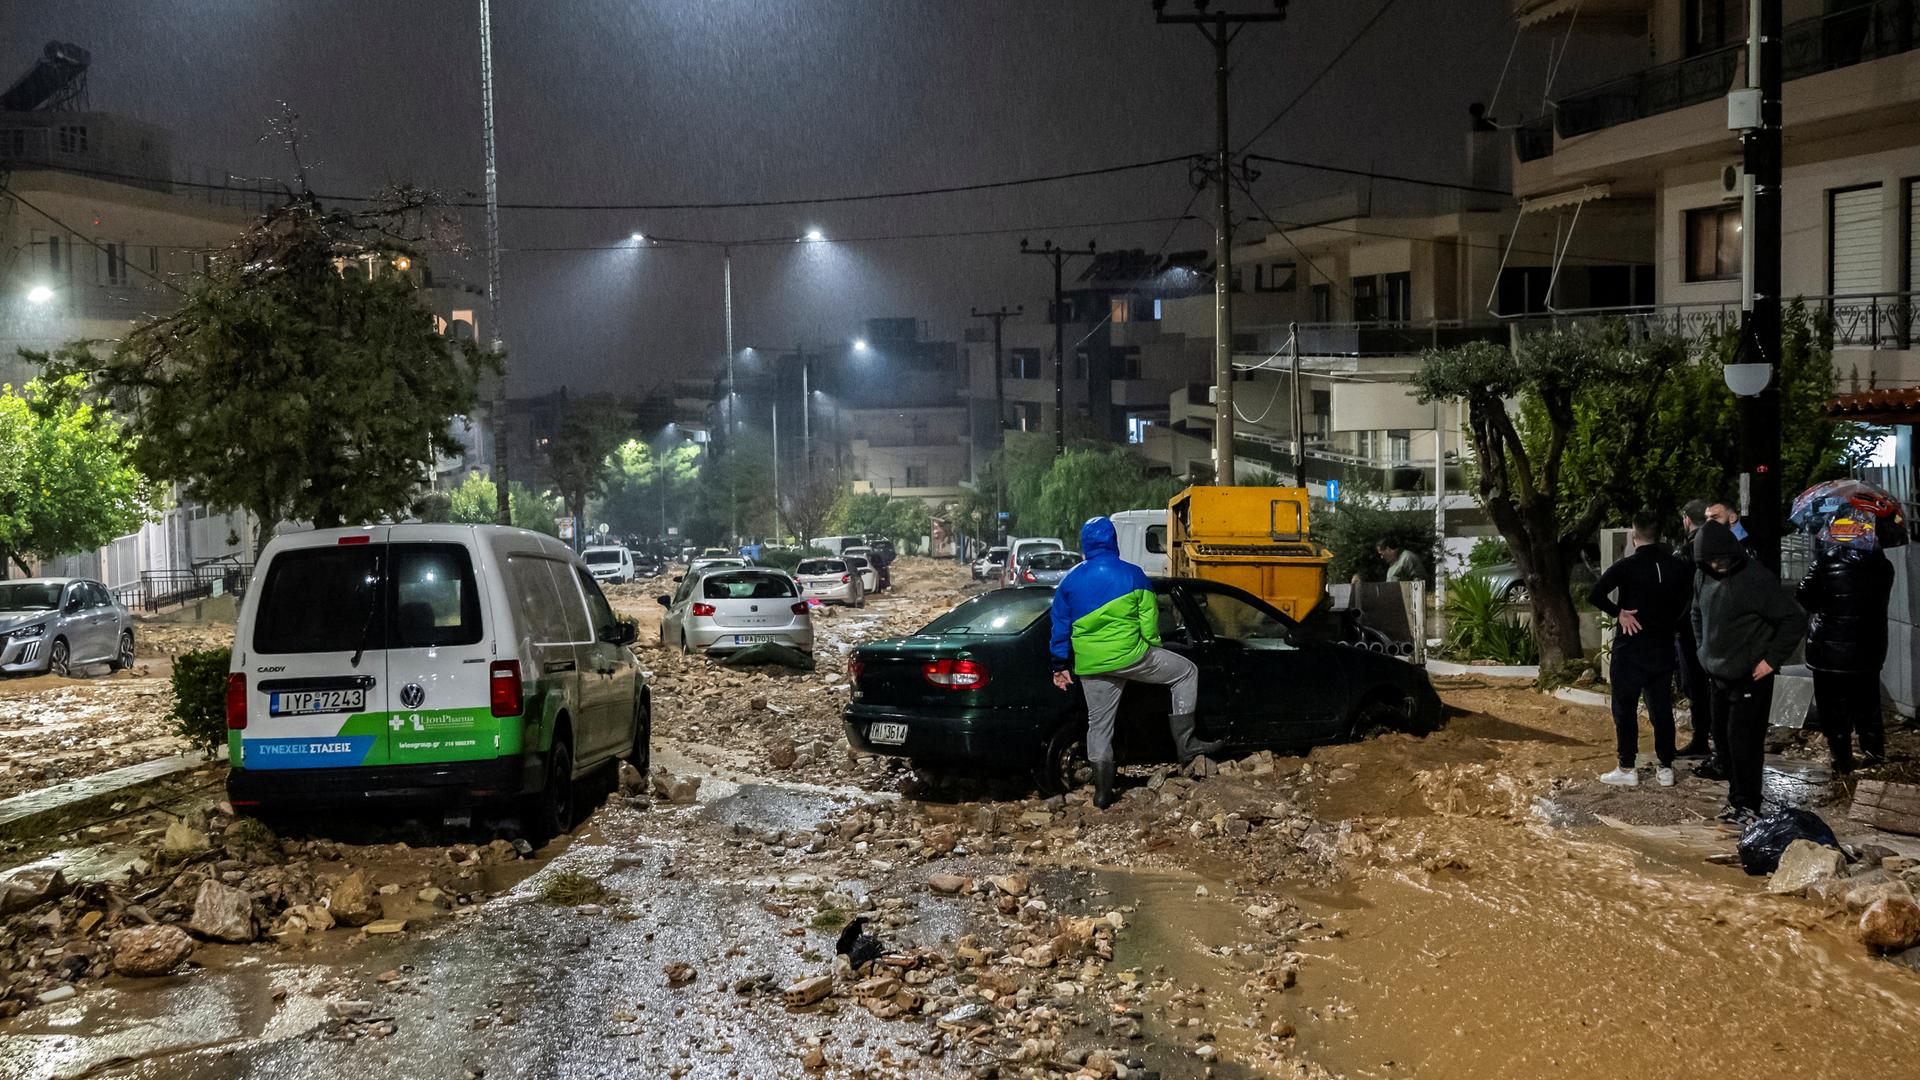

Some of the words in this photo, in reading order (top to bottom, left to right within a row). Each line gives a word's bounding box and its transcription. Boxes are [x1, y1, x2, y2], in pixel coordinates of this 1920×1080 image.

[286, 693, 313, 710] IYP
[321, 690, 361, 708] 7243
[420, 714, 475, 724] LionPharma
[886, 725, 906, 739] 3614
[259, 744, 308, 755] ΣΥΝΕΧΕΙΣ
[309, 742, 352, 754] ΣΤΑΣΕΙΣ
